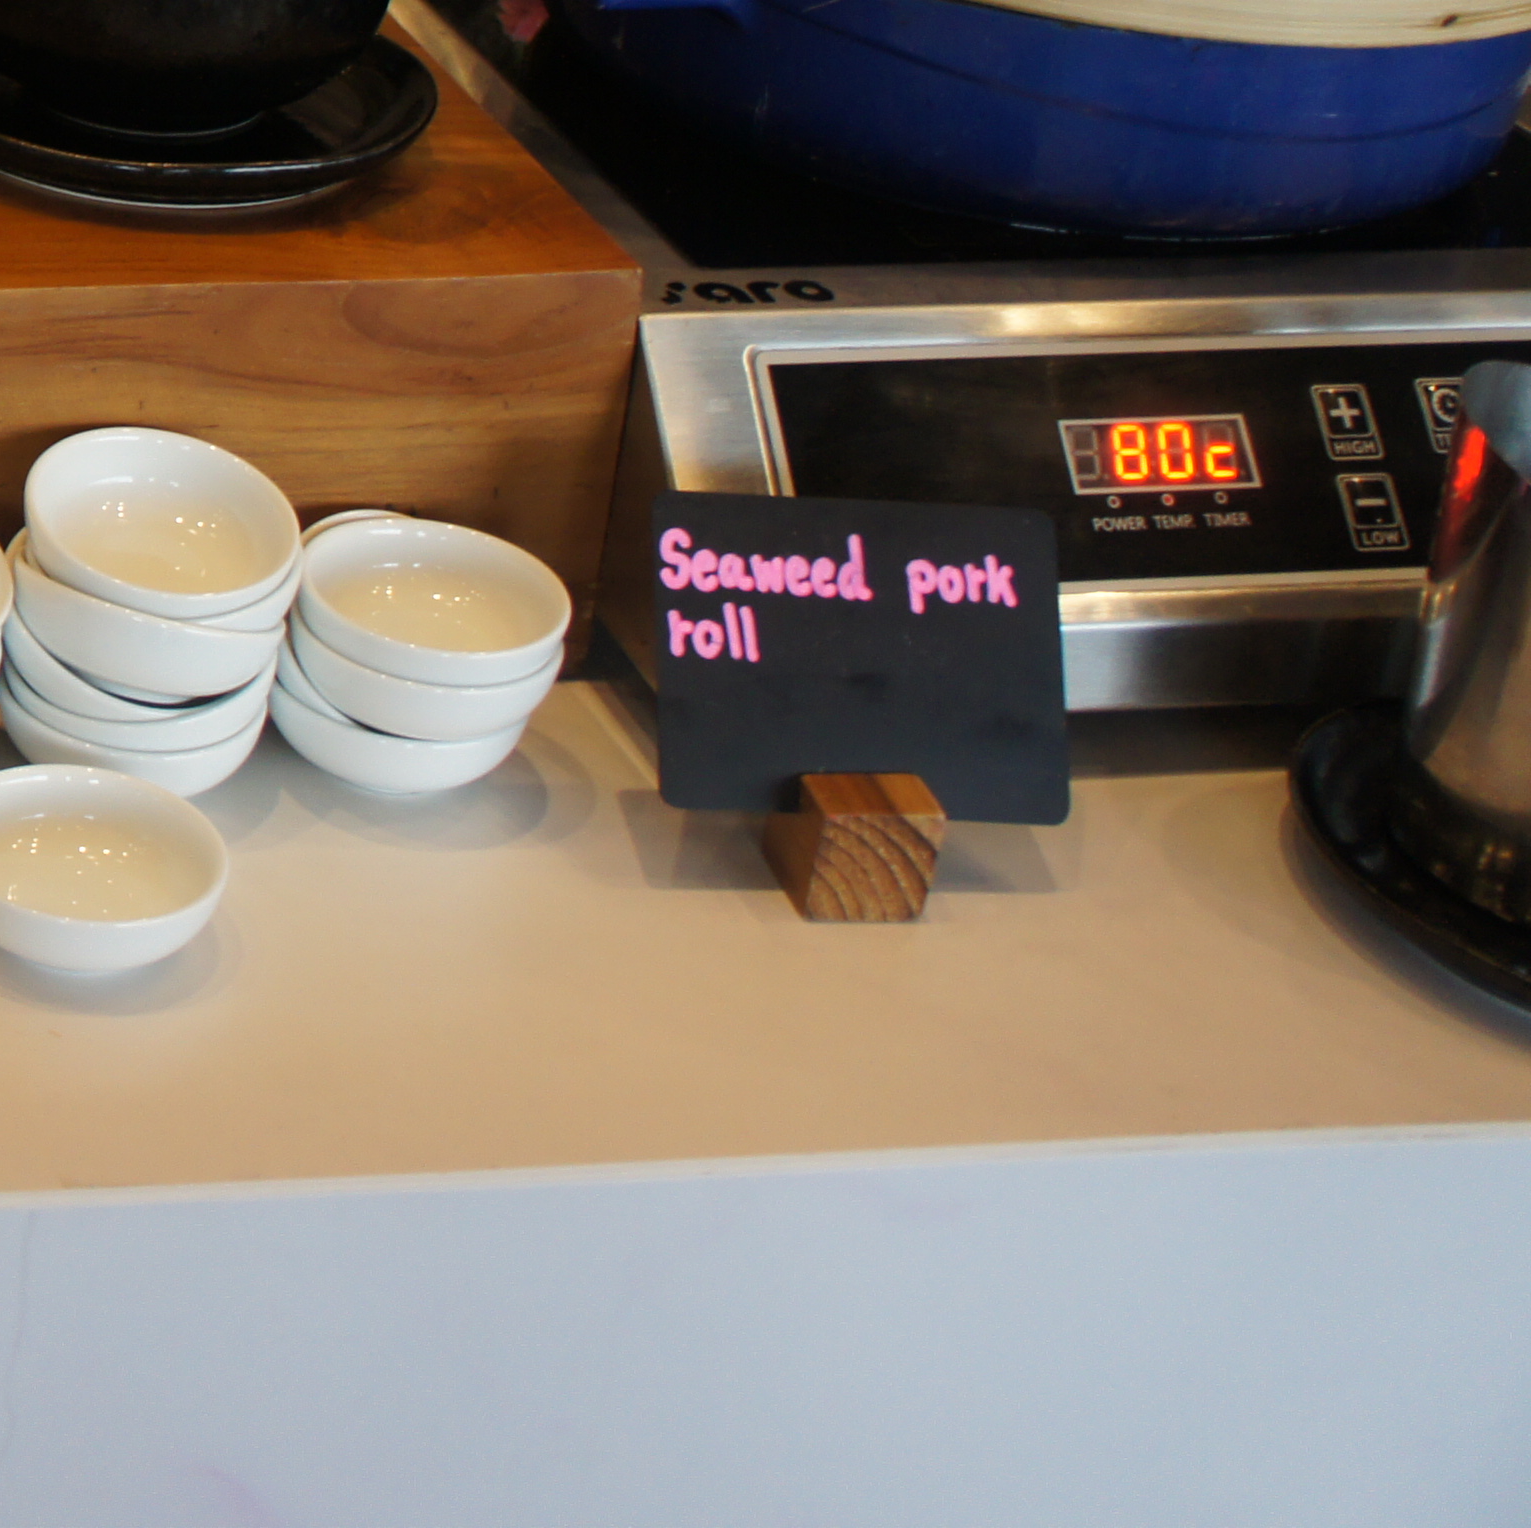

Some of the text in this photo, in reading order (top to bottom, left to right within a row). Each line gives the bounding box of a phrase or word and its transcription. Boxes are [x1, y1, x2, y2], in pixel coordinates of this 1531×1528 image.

[661, 279, 835, 304] saro
[1333, 439, 1378, 455] HIGH
[1091, 515, 1147, 532] POWER
[1203, 511, 1253, 528] TIMER
[1361, 530, 1401, 546] LOW
[659, 527, 1019, 615] Seaweed pork
[667, 602, 760, 663] roll
